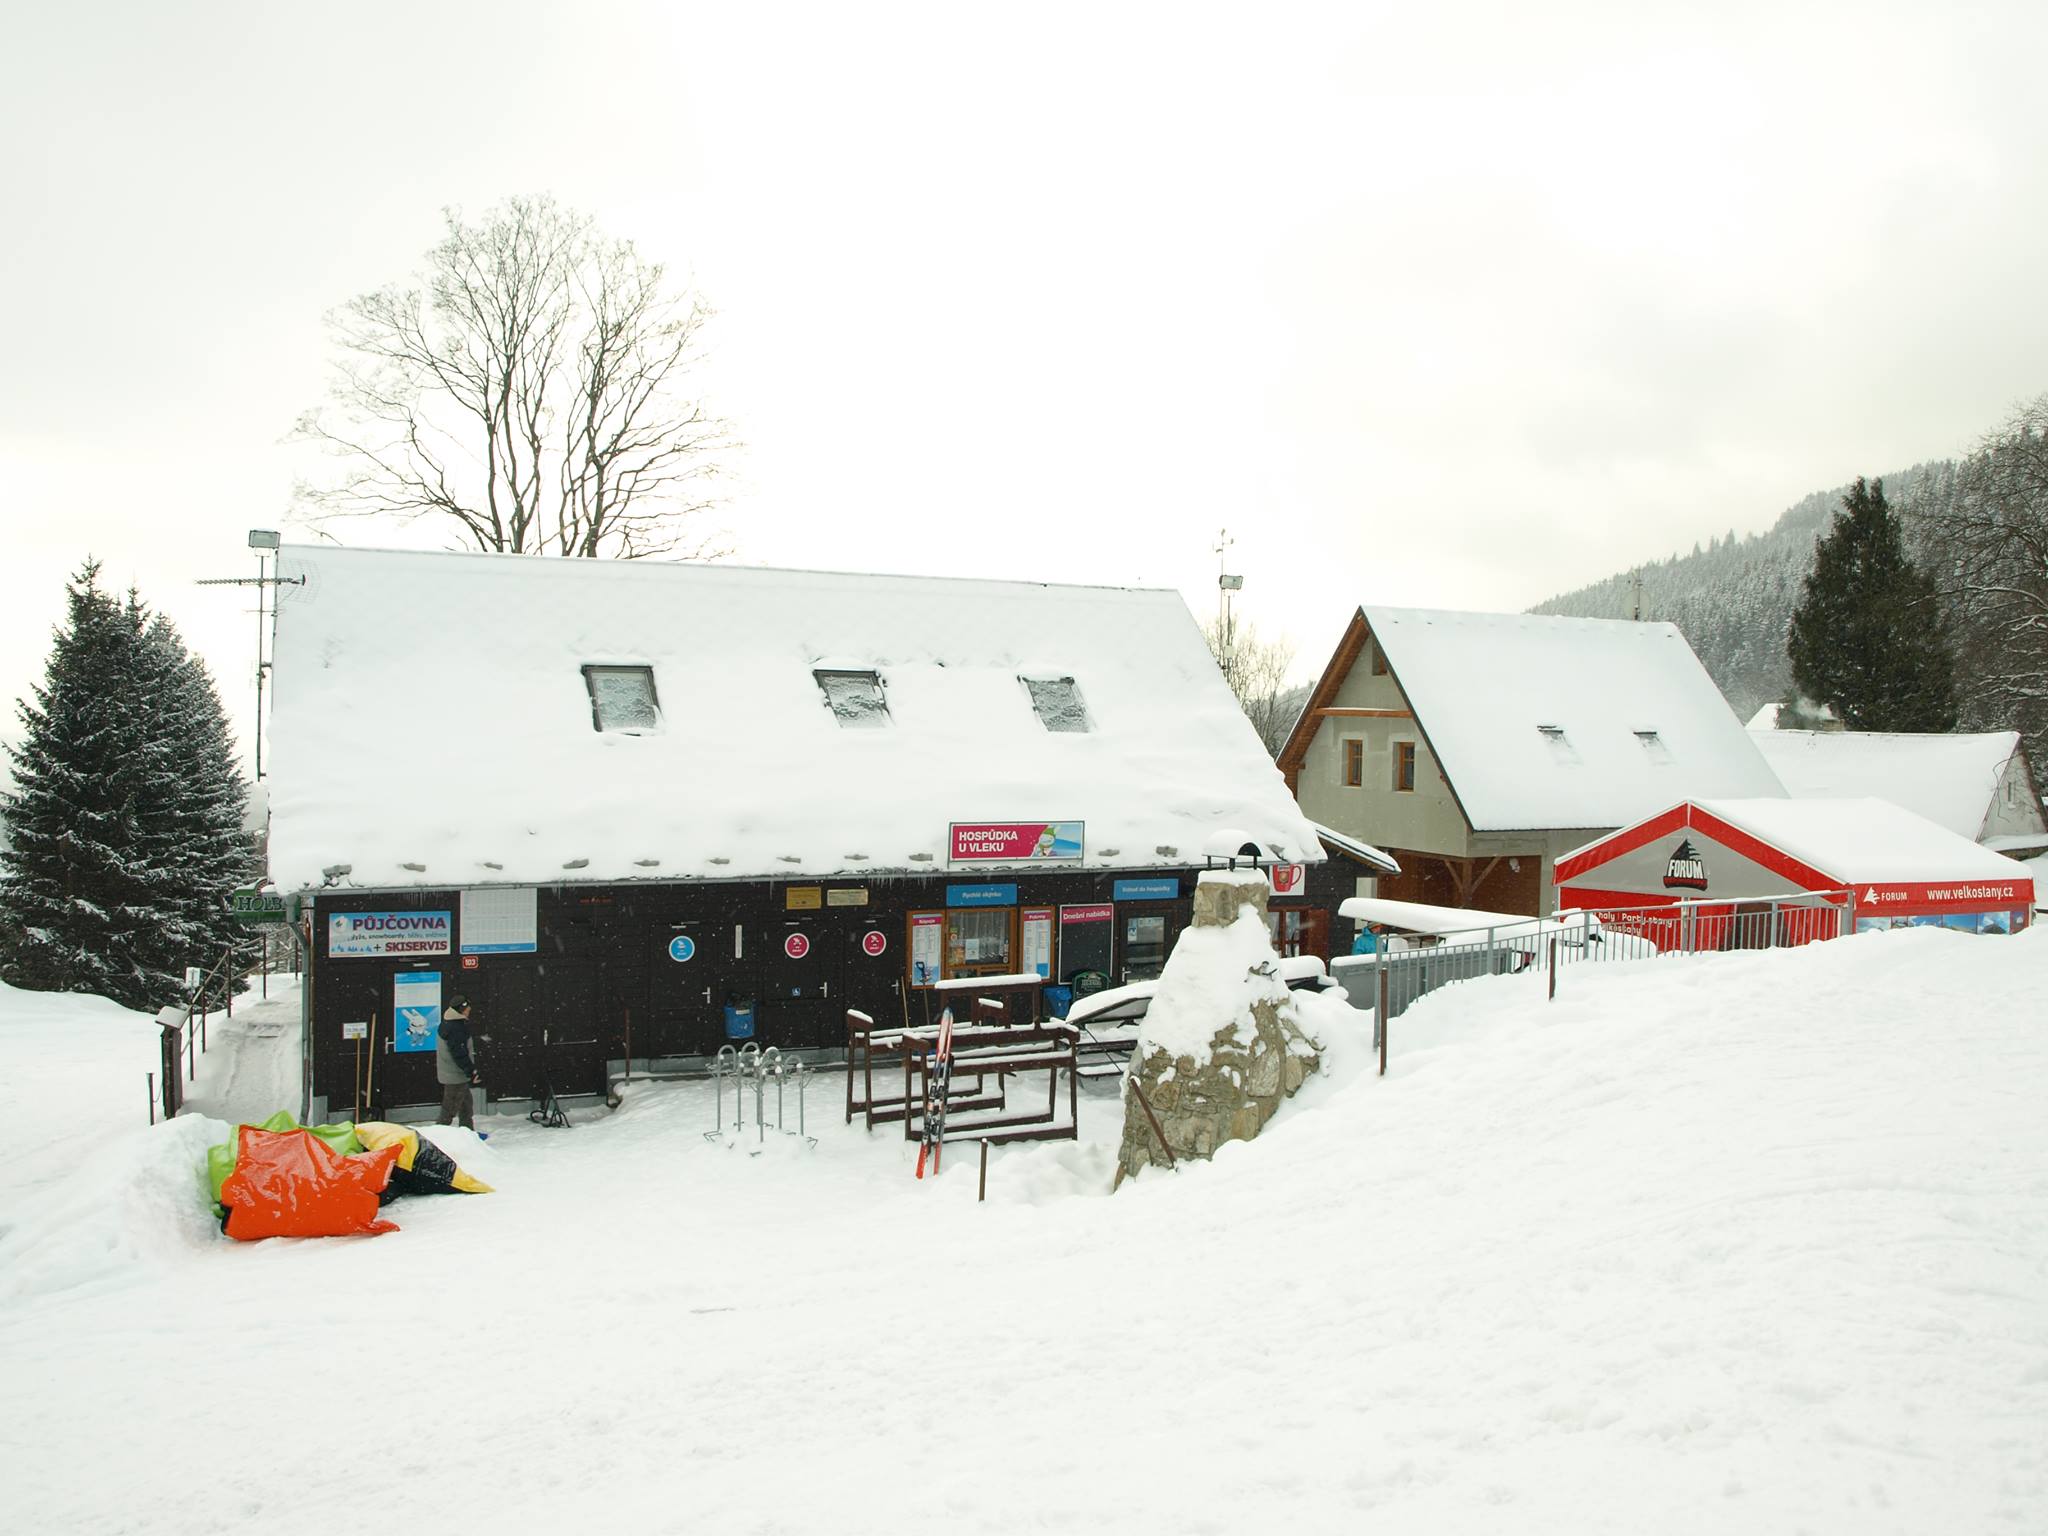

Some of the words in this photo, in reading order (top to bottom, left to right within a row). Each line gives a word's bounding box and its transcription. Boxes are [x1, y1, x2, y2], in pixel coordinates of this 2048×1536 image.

[959, 829, 1018, 841] HOSPŮDKA
[959, 843, 966, 853] U
[969, 842, 1004, 853] VLEKU
[1667, 859, 1704, 879] FORUM
[1881, 892, 1907, 901] FORUM
[1063, 911, 1085, 920] Dnešní
[1086, 910, 1110, 918] nabídka
[1598, 911, 1615, 921] haly
[1621, 912, 1646, 925] Party
[352, 914, 446, 931] PŮJČOVNA
[385, 941, 448, 952] SKISERVIS
[465, 958, 476, 966] 103
